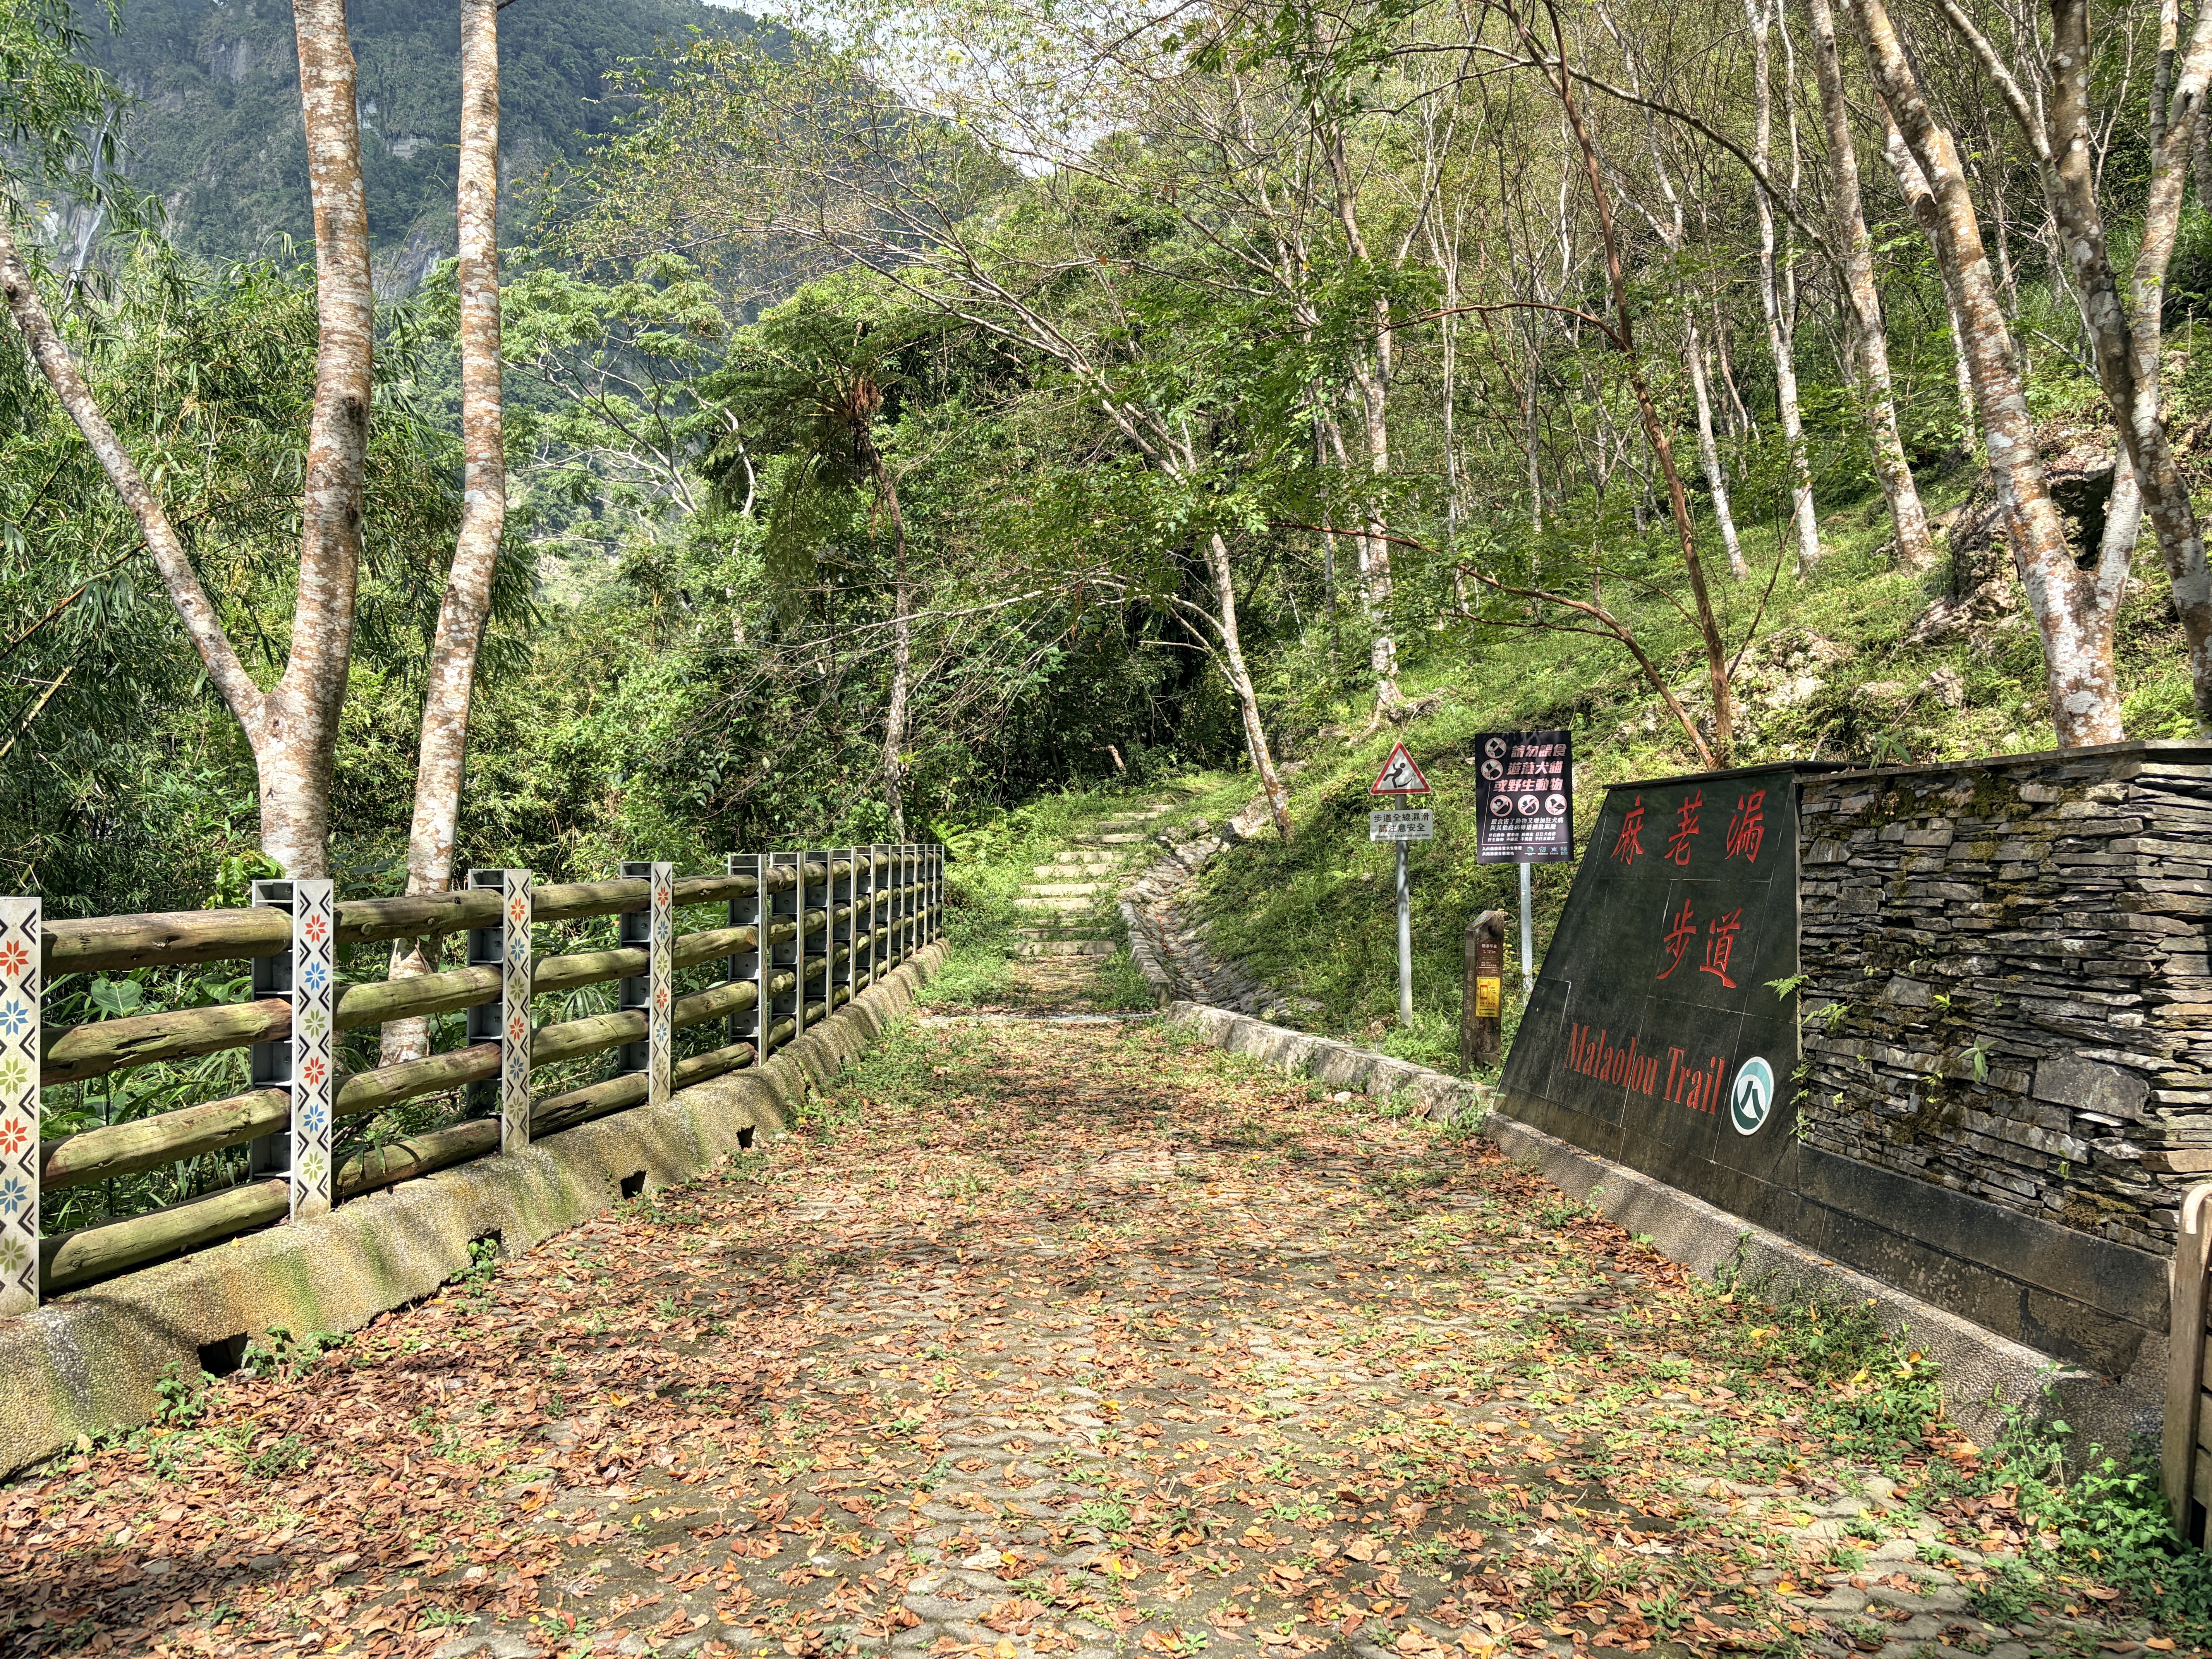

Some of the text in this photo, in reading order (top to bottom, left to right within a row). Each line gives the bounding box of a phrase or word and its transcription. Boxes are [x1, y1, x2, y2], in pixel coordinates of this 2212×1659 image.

[1511, 744, 1567, 758] 請勿餵食
[1507, 761, 1564, 775] 遊蕩犬貓
[1493, 778, 1564, 792] 或野生動物
[1379, 823, 1425, 833] 請注意安全
[1657, 898, 1743, 988] 步道
[1564, 1022, 1725, 1115] Malaolou Trail
